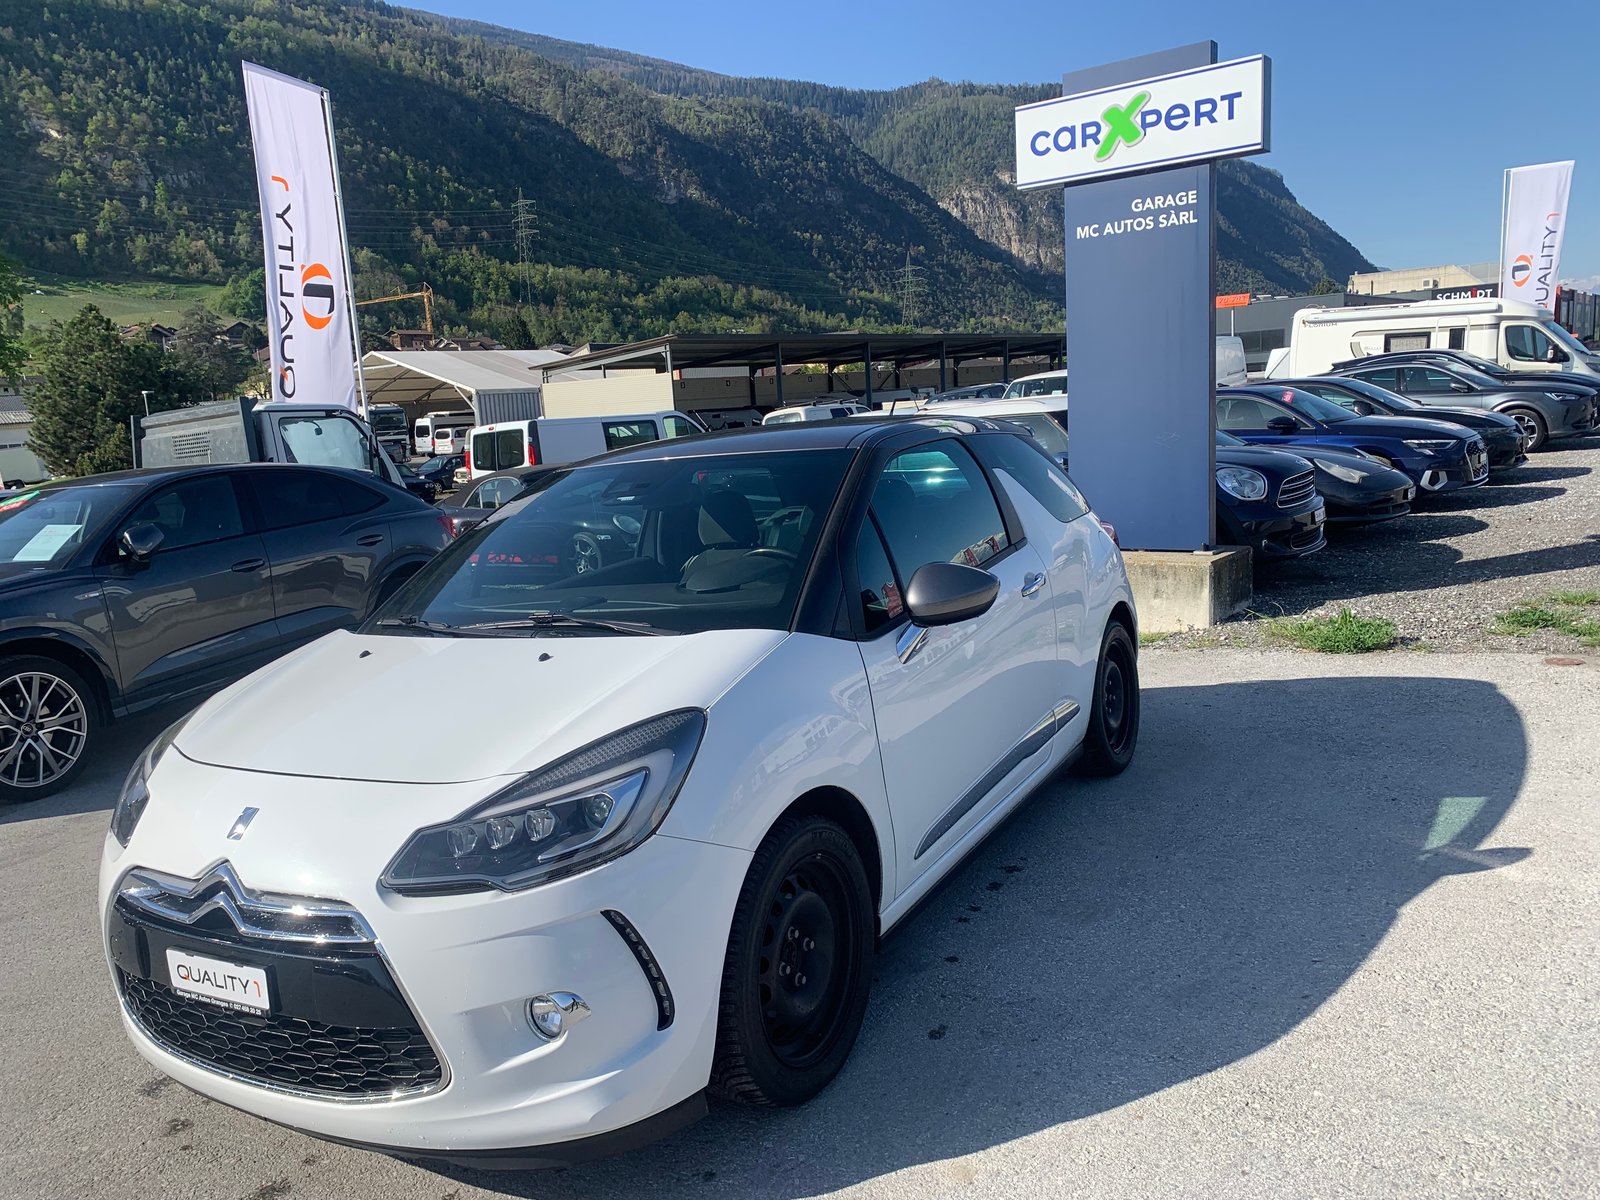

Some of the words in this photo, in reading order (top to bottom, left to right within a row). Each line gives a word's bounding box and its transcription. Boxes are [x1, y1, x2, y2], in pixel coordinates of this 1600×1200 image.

[1131, 190, 1198, 212] GARAGE
[1076, 225, 1100, 240] MC
[1103, 217, 1155, 236] AUTOS
[1158, 209, 1198, 228] SÀRL
